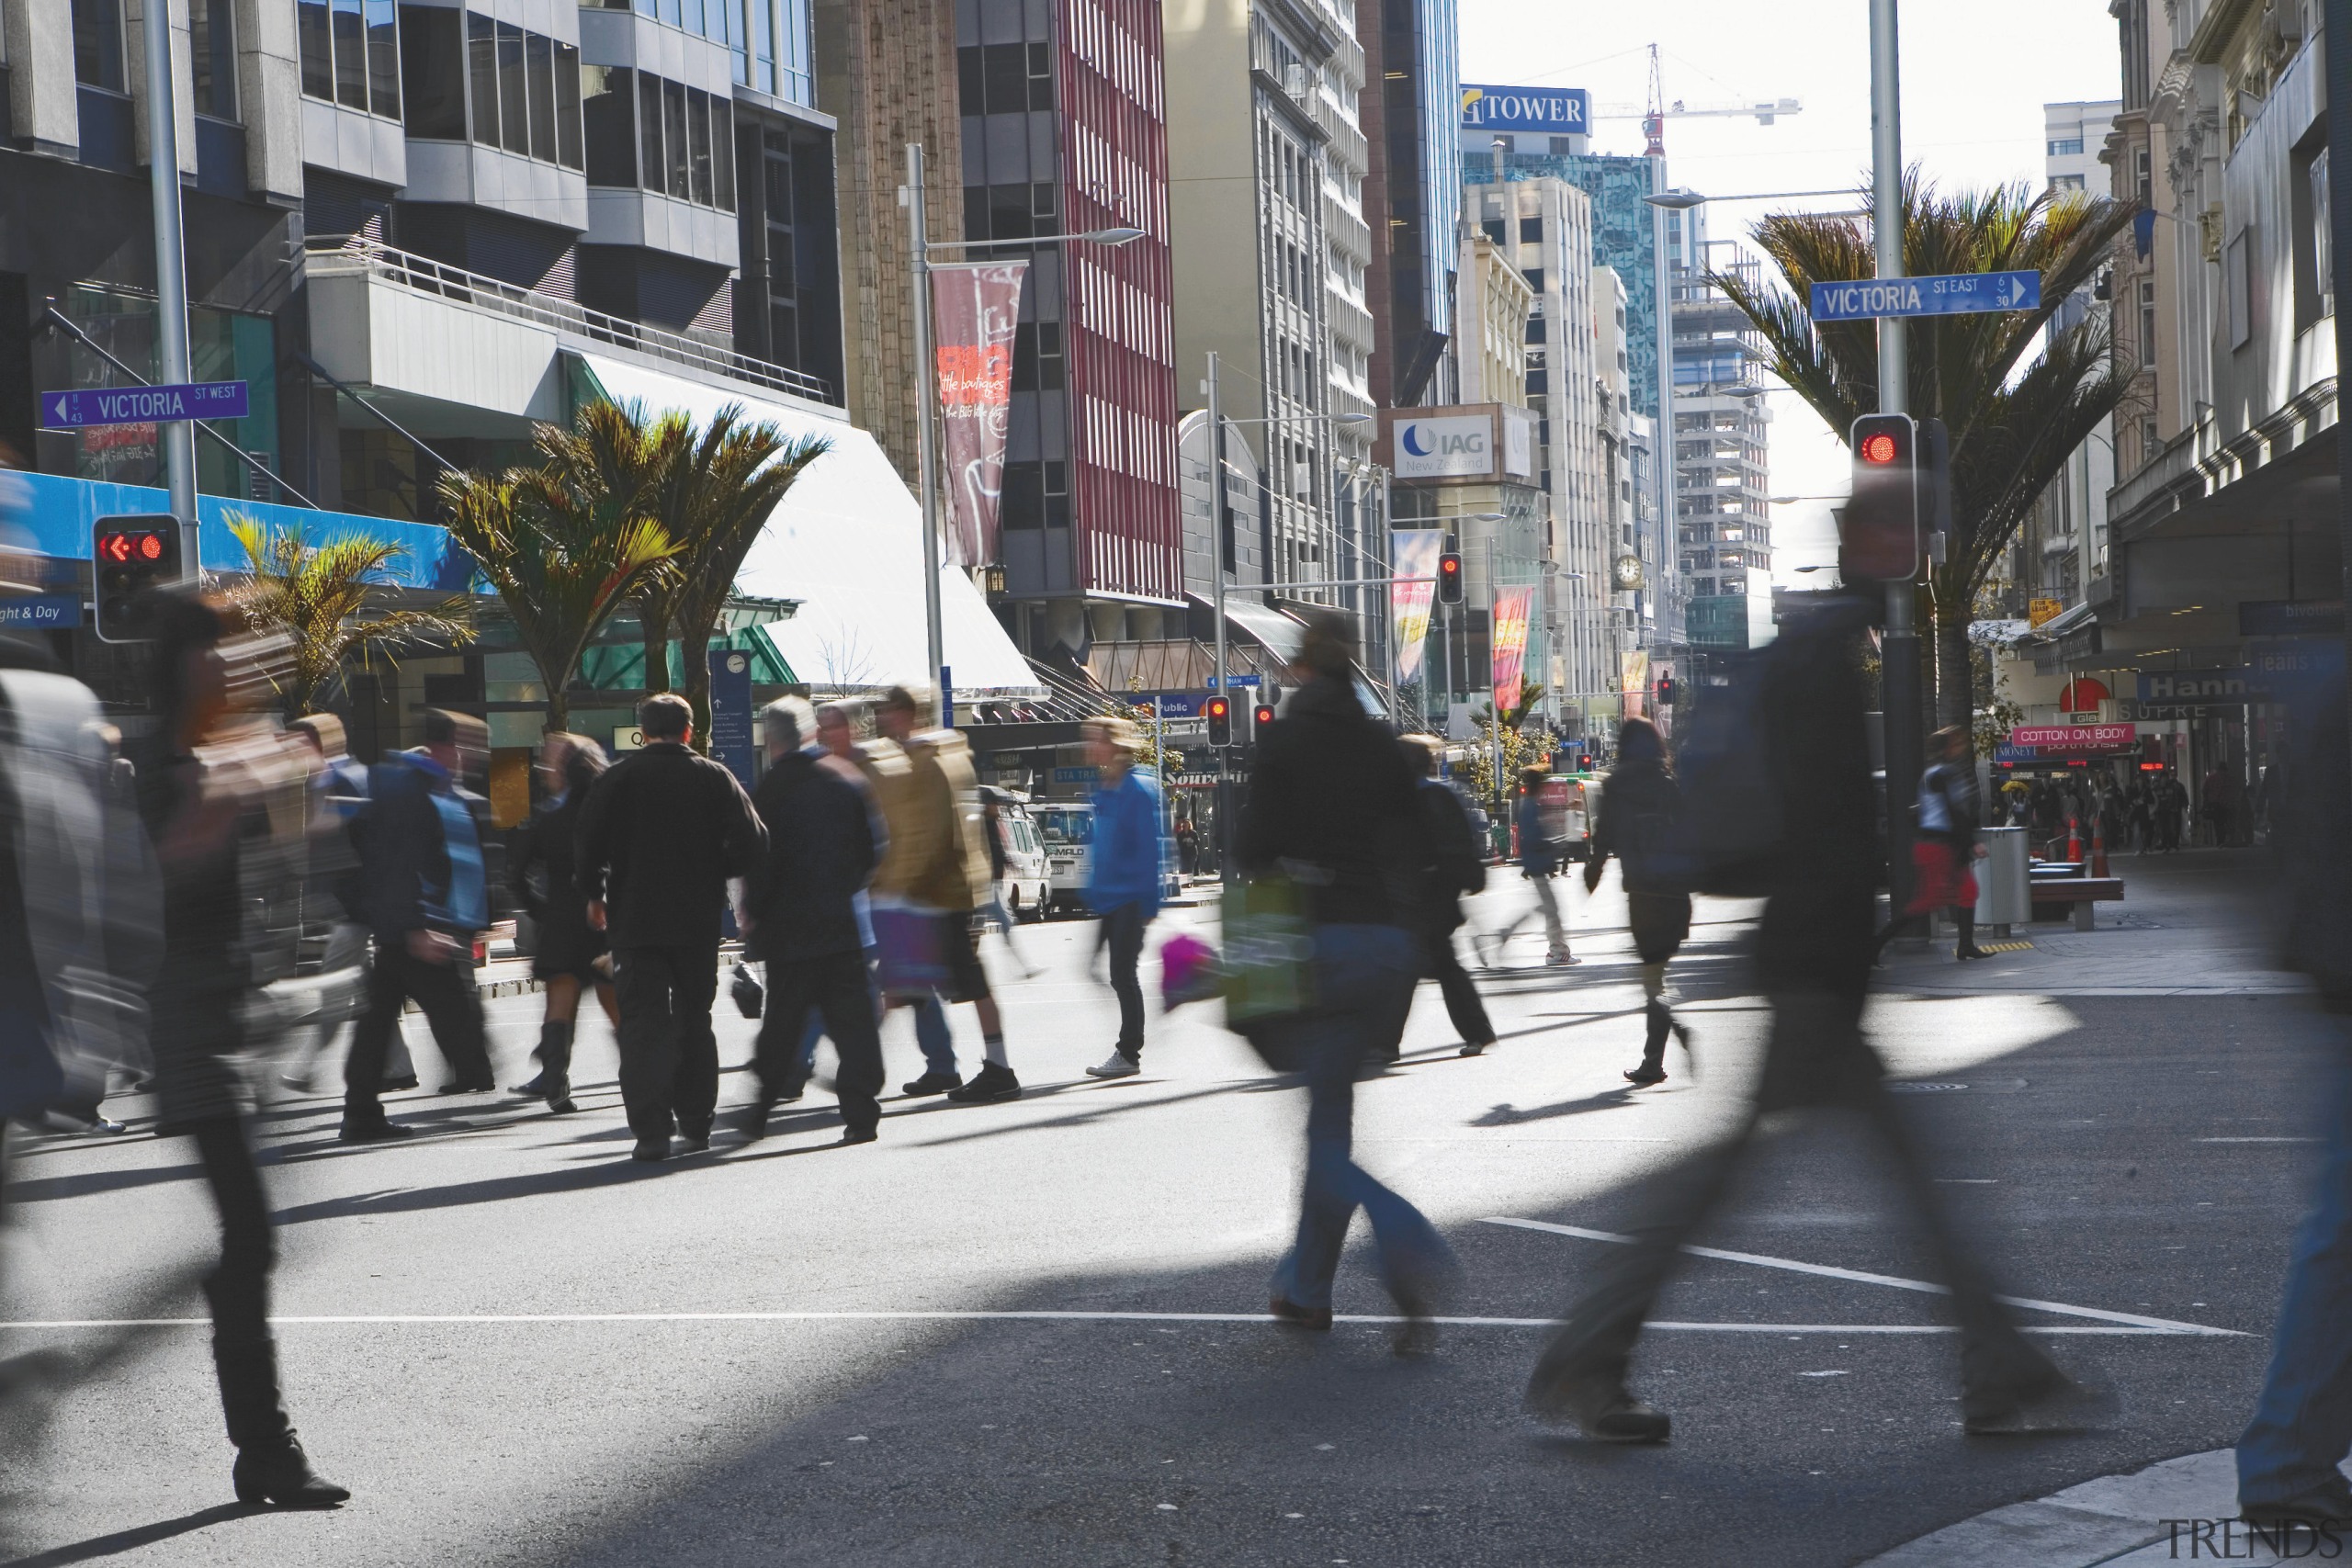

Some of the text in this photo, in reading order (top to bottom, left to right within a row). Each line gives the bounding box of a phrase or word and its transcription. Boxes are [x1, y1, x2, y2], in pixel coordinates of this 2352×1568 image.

[1484, 96, 1583, 122] TOWER
[1998, 276, 2005, 287] 6
[1824, 278, 1979, 313] VICTORIA ST EAST
[1996, 295, 2009, 307] 30
[961, 368, 1005, 398] boutiques
[98, 386, 236, 419] VICTORIA ST WEST
[71, 412, 83, 423] 43
[946, 403, 957, 418] the
[958, 404, 973, 419] BIG
[1442, 433, 1484, 456] IAG
[1406, 457, 1483, 472] New Zealand
[0, 605, 60, 623] ght & Day
[2151, 677, 2245, 697] Hann
[1159, 703, 1188, 712] Public
[2021, 728, 2127, 741] COTTON ON BODY
[1999, 746, 2030, 757] MONEY
[1057, 771, 1097, 780] STA TRA
